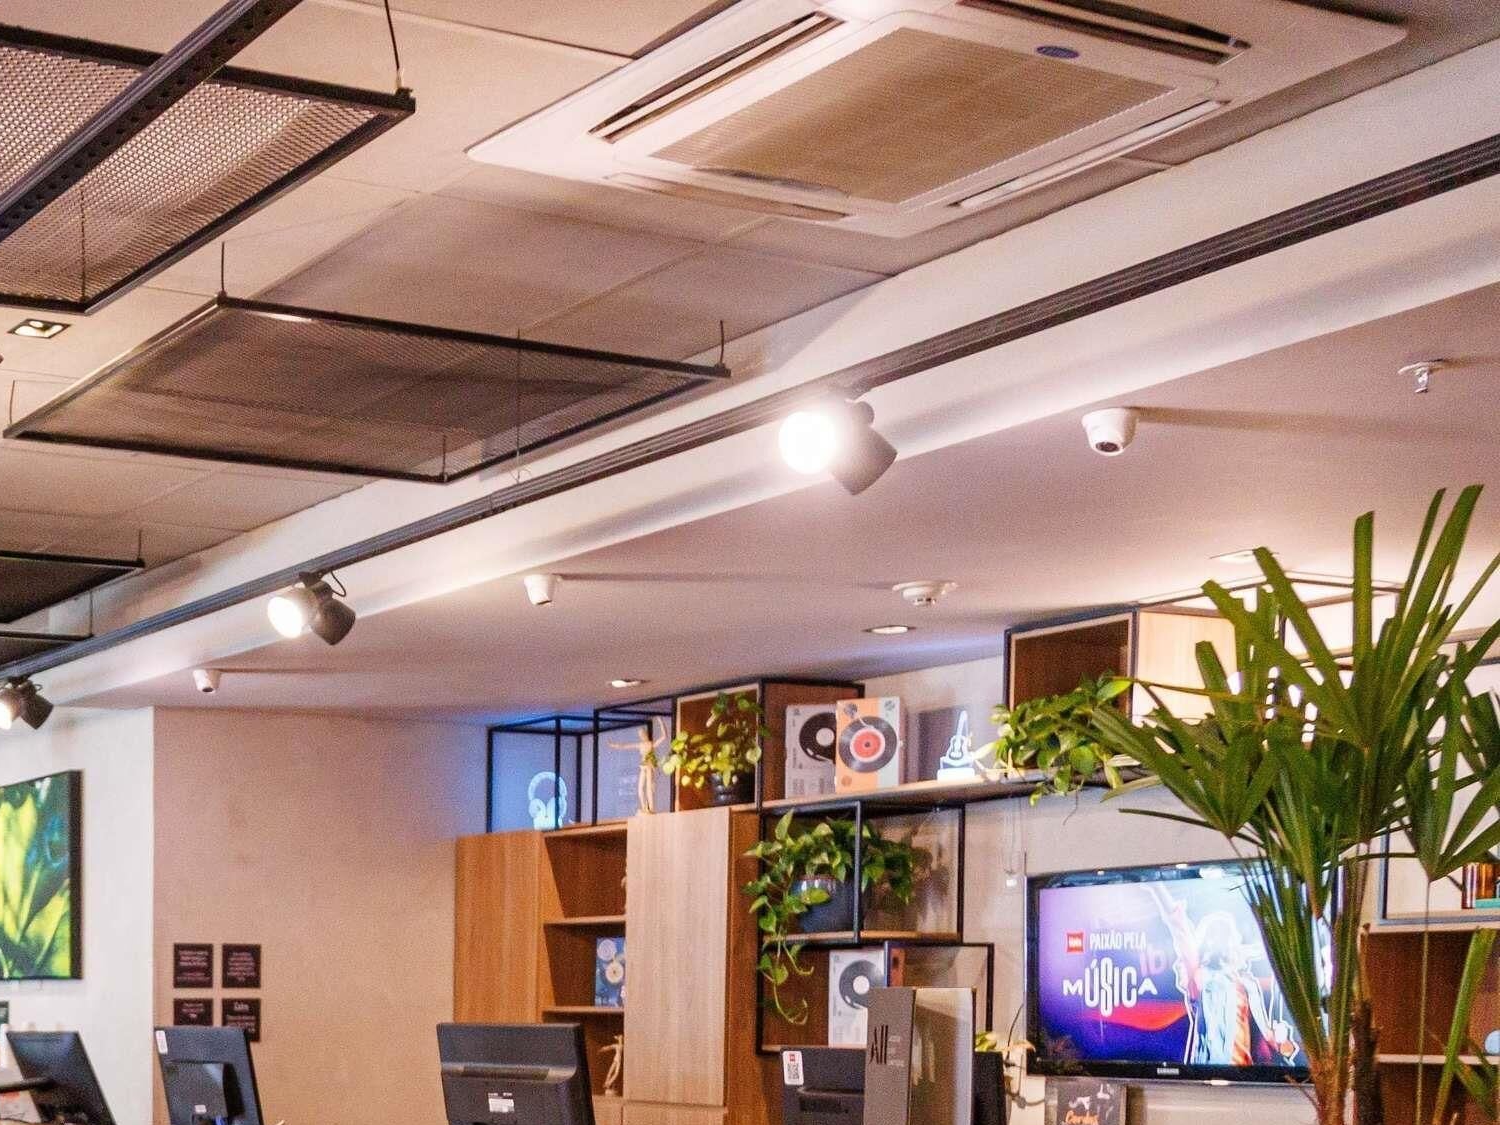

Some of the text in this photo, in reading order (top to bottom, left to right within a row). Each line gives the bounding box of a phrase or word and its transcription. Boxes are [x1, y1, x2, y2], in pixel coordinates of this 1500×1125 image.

[1089, 930, 1123, 949] PAIXÃO
[1124, 932, 1147, 949] PELA
[1062, 957, 1158, 1017] MÚSICA
